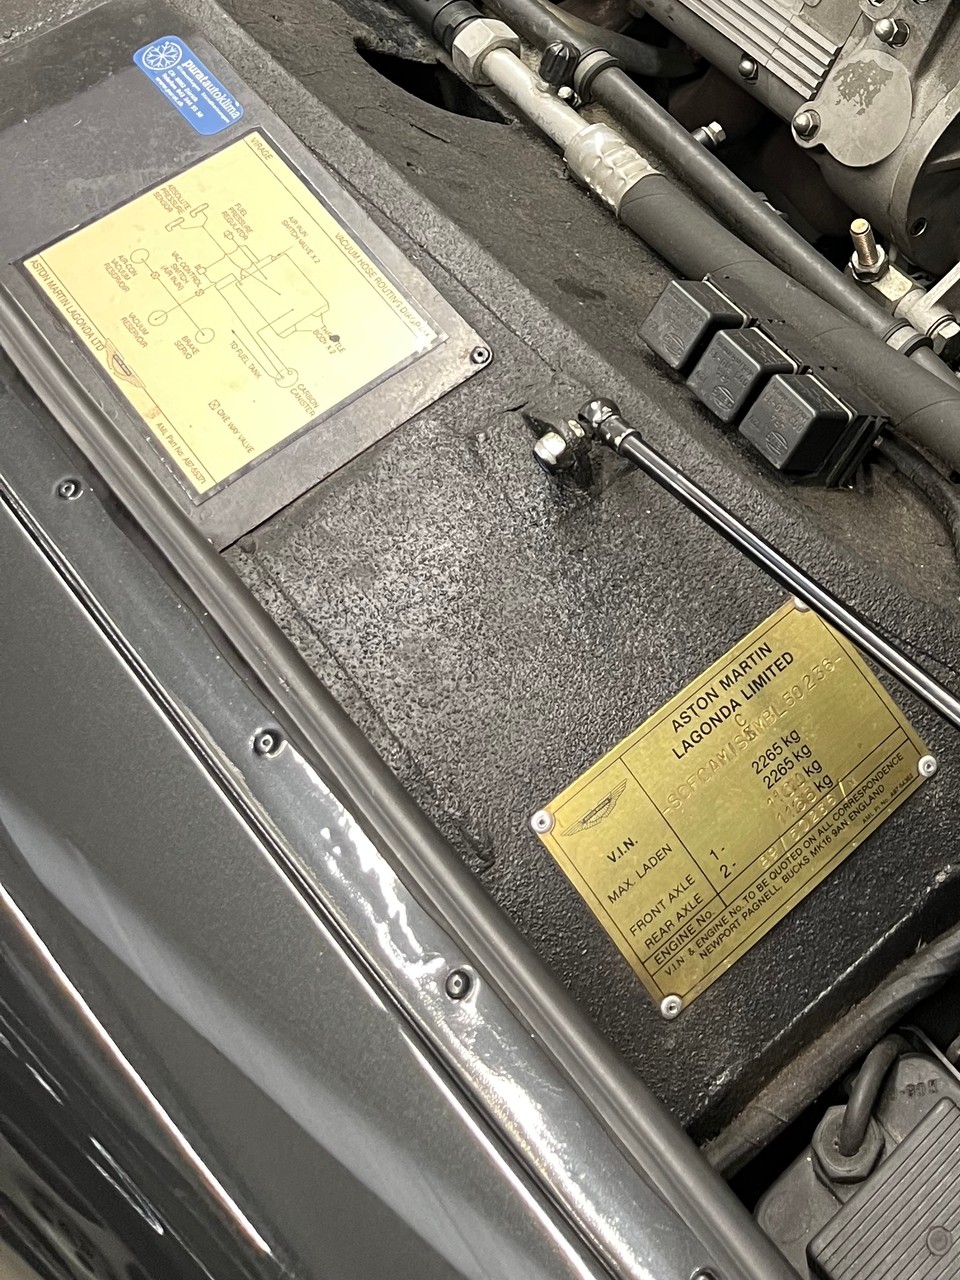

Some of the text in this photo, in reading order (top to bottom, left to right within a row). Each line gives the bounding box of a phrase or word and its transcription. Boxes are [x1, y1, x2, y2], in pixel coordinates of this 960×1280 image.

[251, 137, 273, 160] VIRAGE
[153, 192, 173, 212] SENSOR
[161, 188, 185, 215] PRESSURE
[168, 185, 191, 210] ABSOLUTE
[235, 203, 247, 217] FUEL
[221, 211, 248, 240] REGULATOR
[228, 207, 253, 234] PRESSURE
[281, 220, 300, 239] SWITCH
[299, 239, 313, 255] VALVE
[104, 263, 130, 292] RESERVOIR
[111, 258, 131, 280] VACUUM
[118, 255, 137, 276] AIR-CON
[170, 263, 189, 284] SWITCH
[172, 251, 201, 288] VAC CONTROL
[335, 233, 360, 259] VACUUM
[358, 259, 377, 278] HOSE
[374, 277, 403, 308] ROUTING
[30, 260, 107, 351] ASTON MARTIN LAGONDA LTD
[121, 317, 148, 348] RESERVOIR
[128, 312, 149, 335] VACUUM
[313, 329, 327, 344] BODY
[174, 340, 192, 359] SERVO
[182, 336, 199, 354] BRAKE
[318, 323, 346, 354] THRTLE
[230, 340, 262, 379] TO FUEL TANK
[290, 388, 315, 416] CANISTER
[297, 384, 319, 408] CARBON
[217, 409, 254, 453] ONE WAY VALVE
[672, 642, 772, 733] ASTON MARTIN
[672, 652, 793, 759] LAGONDA LIMITED
[763, 744, 812, 789] 2265 kg
[607, 730, 800, 904] MAX. LADEN 2265 kg
[607, 837, 638, 862] V.I.N.
[630, 899, 666, 936] FRONT
[669, 874, 695, 903] AXLE
[803, 760, 822, 777] kg
[644, 920, 675, 950] REAR
[677, 893, 704, 922] AXLE
[813, 775, 833, 792] kg
[688, 948, 696, 956] &
[696, 915, 729, 948] ENGINE
[742, 891, 756, 903] TO
[756, 878, 769, 892] BE
[769, 848, 802, 880] QUOTED
[803, 835, 817, 848] ON
[818, 822, 833, 837] ALL
[833, 752, 903, 821] CORRESPONDENCE
[699, 918, 741, 960] NEWPORT
[782, 856, 810, 883] BUCKS
[810, 835, 831, 857] MK16
[832, 819, 849, 837] 9AN
[848, 785, 884, 821] ENGLAND
[654, 924, 699, 965] ENGINE
